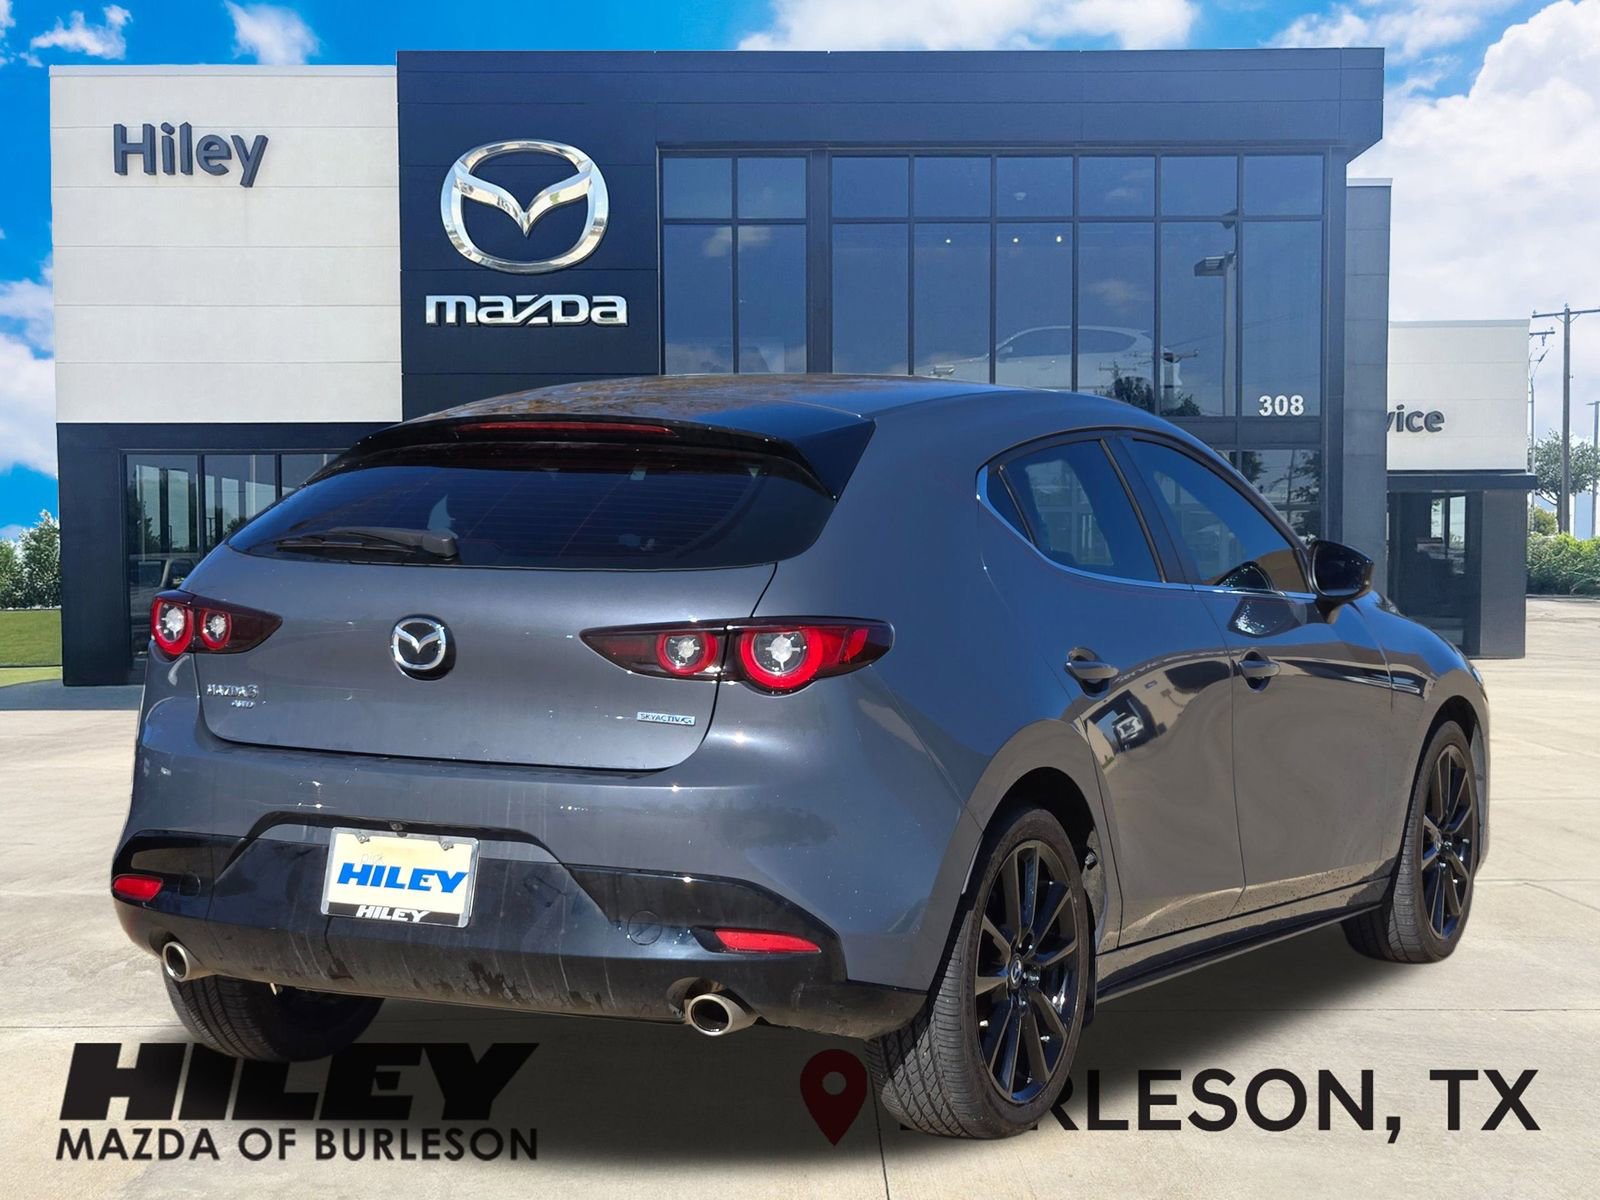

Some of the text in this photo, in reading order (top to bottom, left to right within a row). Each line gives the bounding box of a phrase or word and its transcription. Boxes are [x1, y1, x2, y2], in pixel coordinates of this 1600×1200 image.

[112, 121, 269, 188] Hiley
[1258, 395, 1305, 417] 308
[336, 862, 468, 893] HILEY
[355, 904, 431, 922] HILEY
